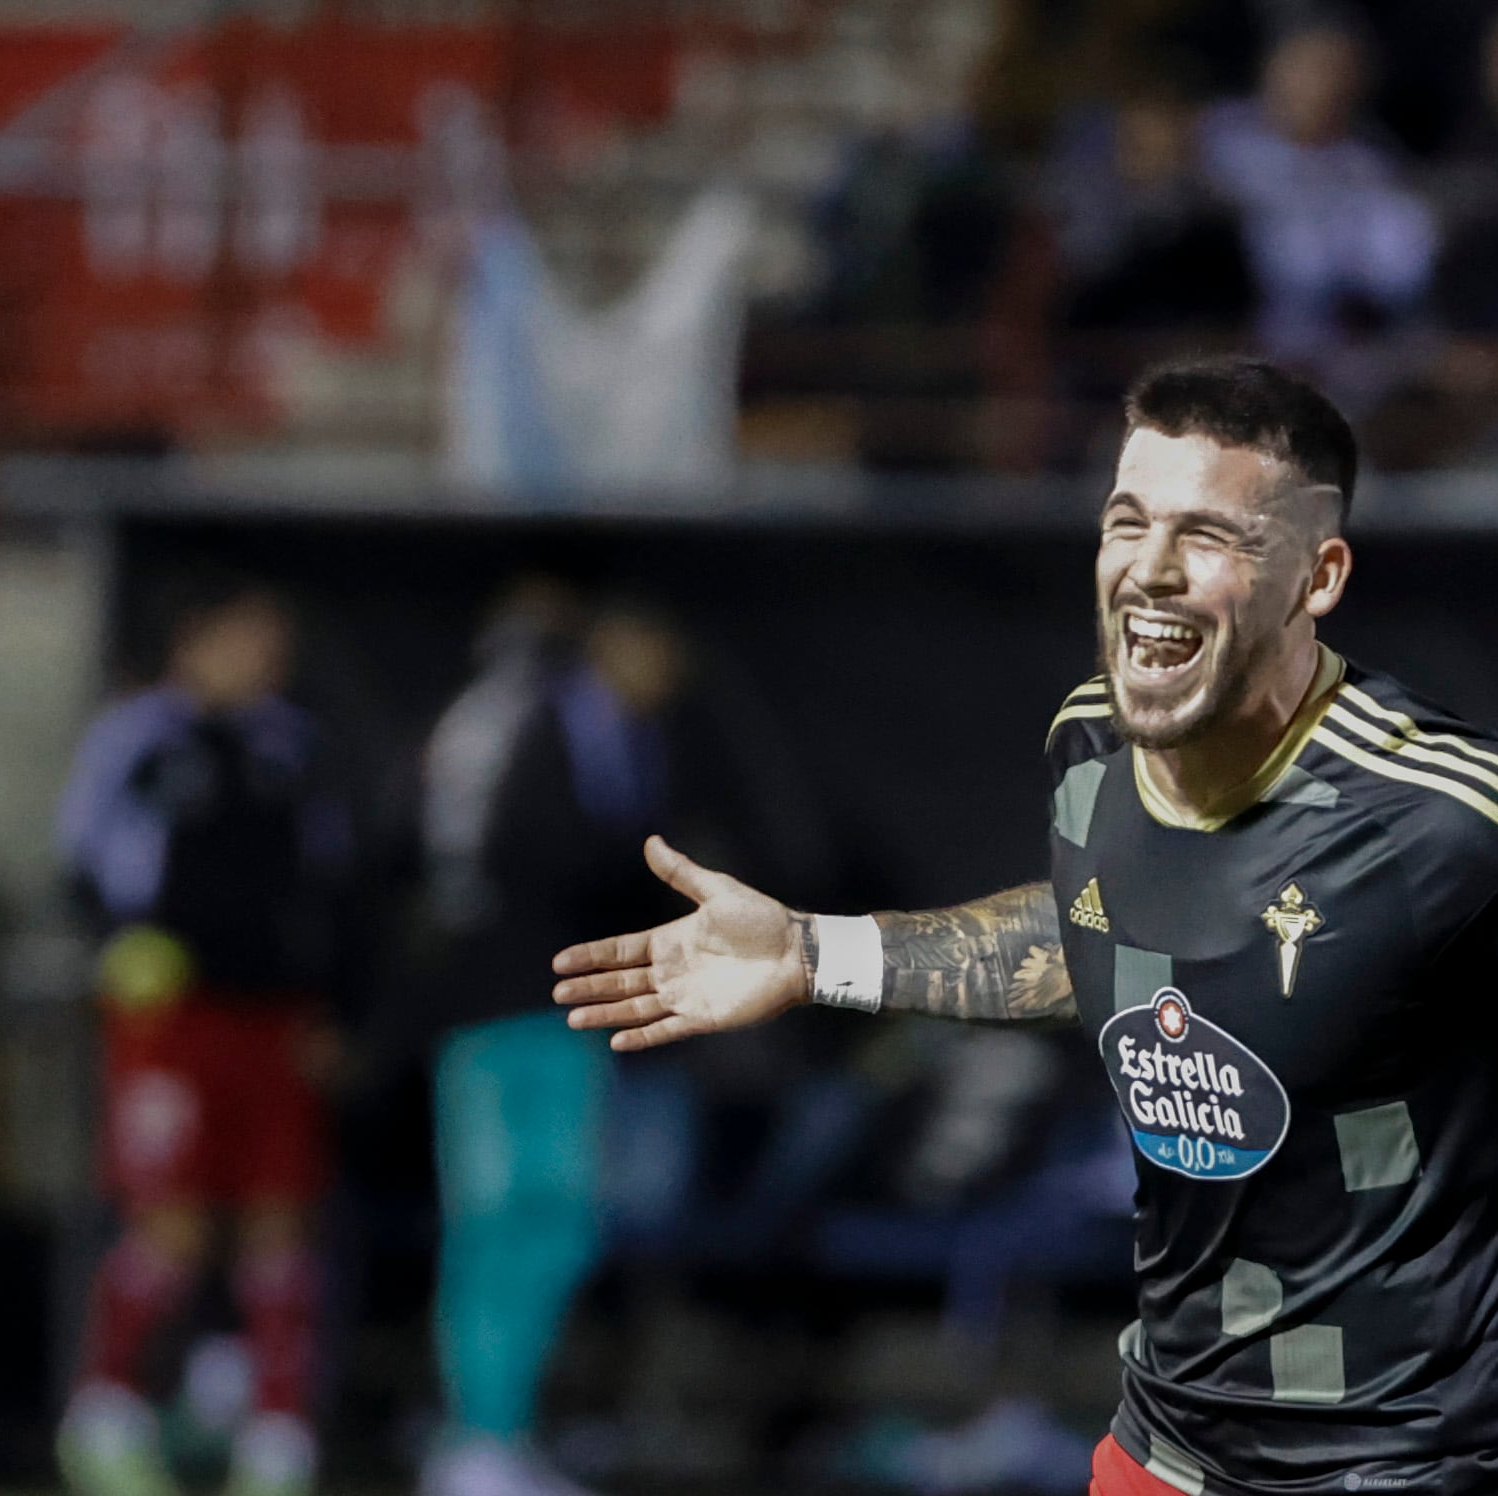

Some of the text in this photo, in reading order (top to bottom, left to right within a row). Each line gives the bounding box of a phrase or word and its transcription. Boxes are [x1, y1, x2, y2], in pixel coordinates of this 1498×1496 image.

[1070, 907, 1109, 932] adidas
[1118, 1035, 1244, 1096] Estrella
[1130, 1080, 1245, 1140] Galicia
[1178, 1134, 1215, 1171] 0,0
